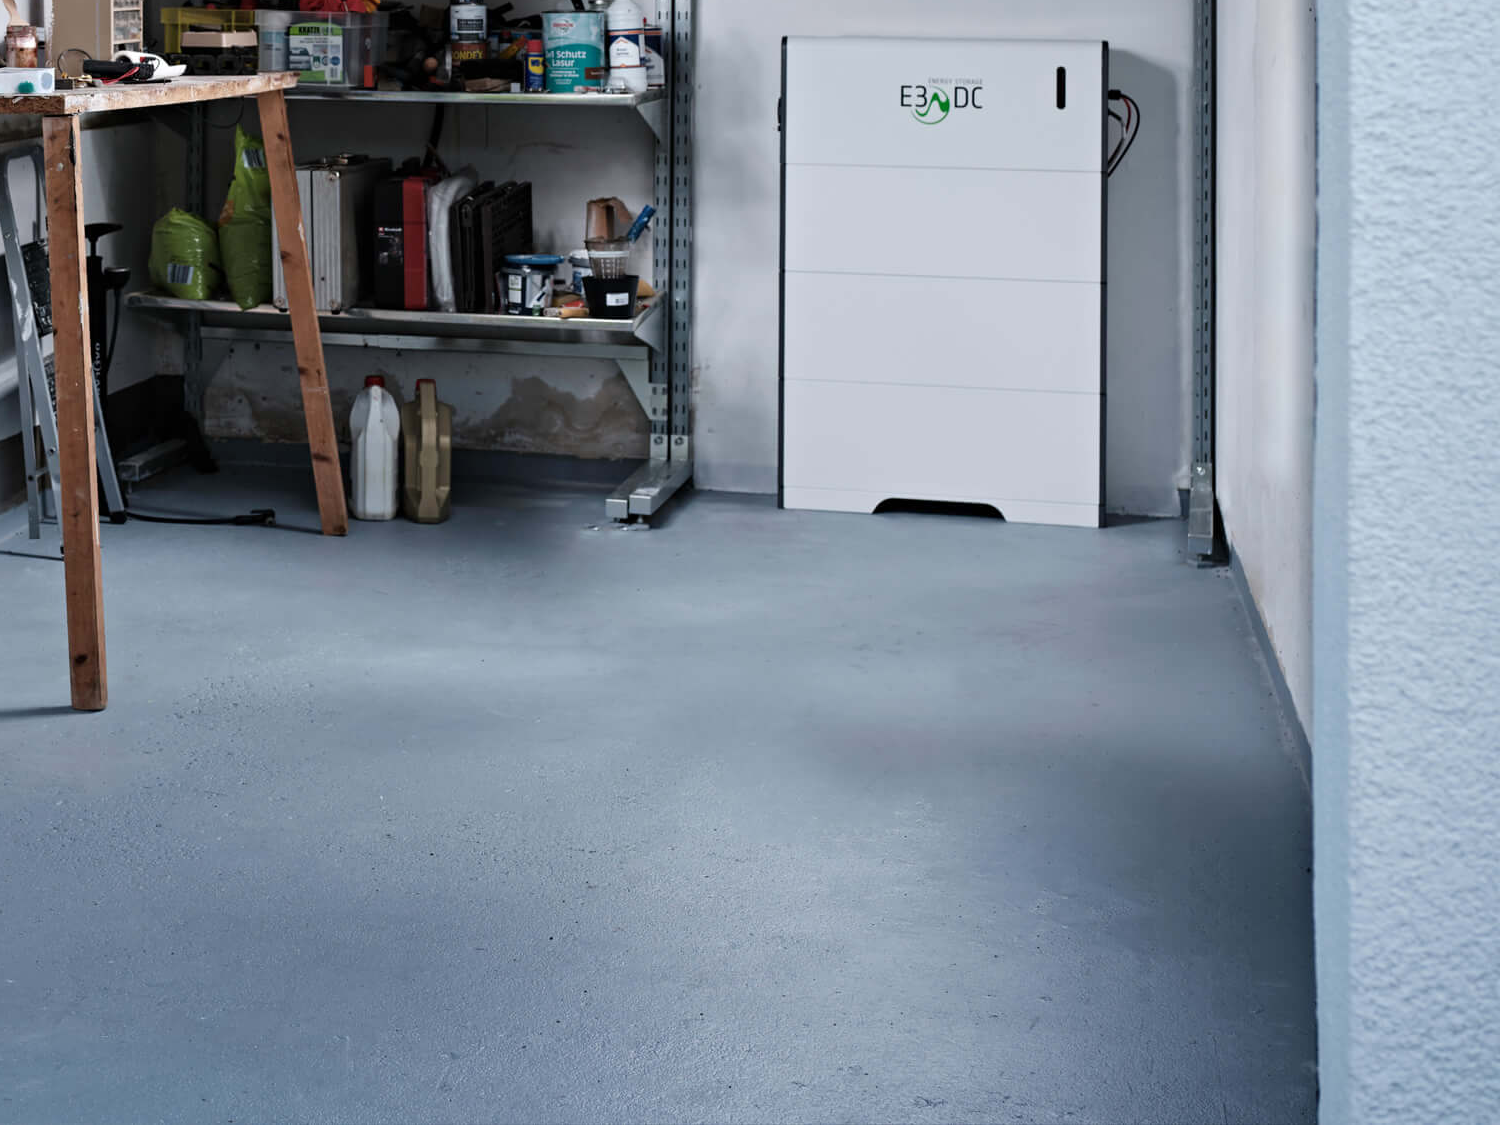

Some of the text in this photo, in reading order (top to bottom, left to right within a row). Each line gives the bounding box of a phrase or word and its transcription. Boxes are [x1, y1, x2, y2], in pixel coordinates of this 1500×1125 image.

[452, 50, 484, 60] ONDEX
[556, 50, 587, 59] Schutz
[552, 59, 575, 67] Lasur
